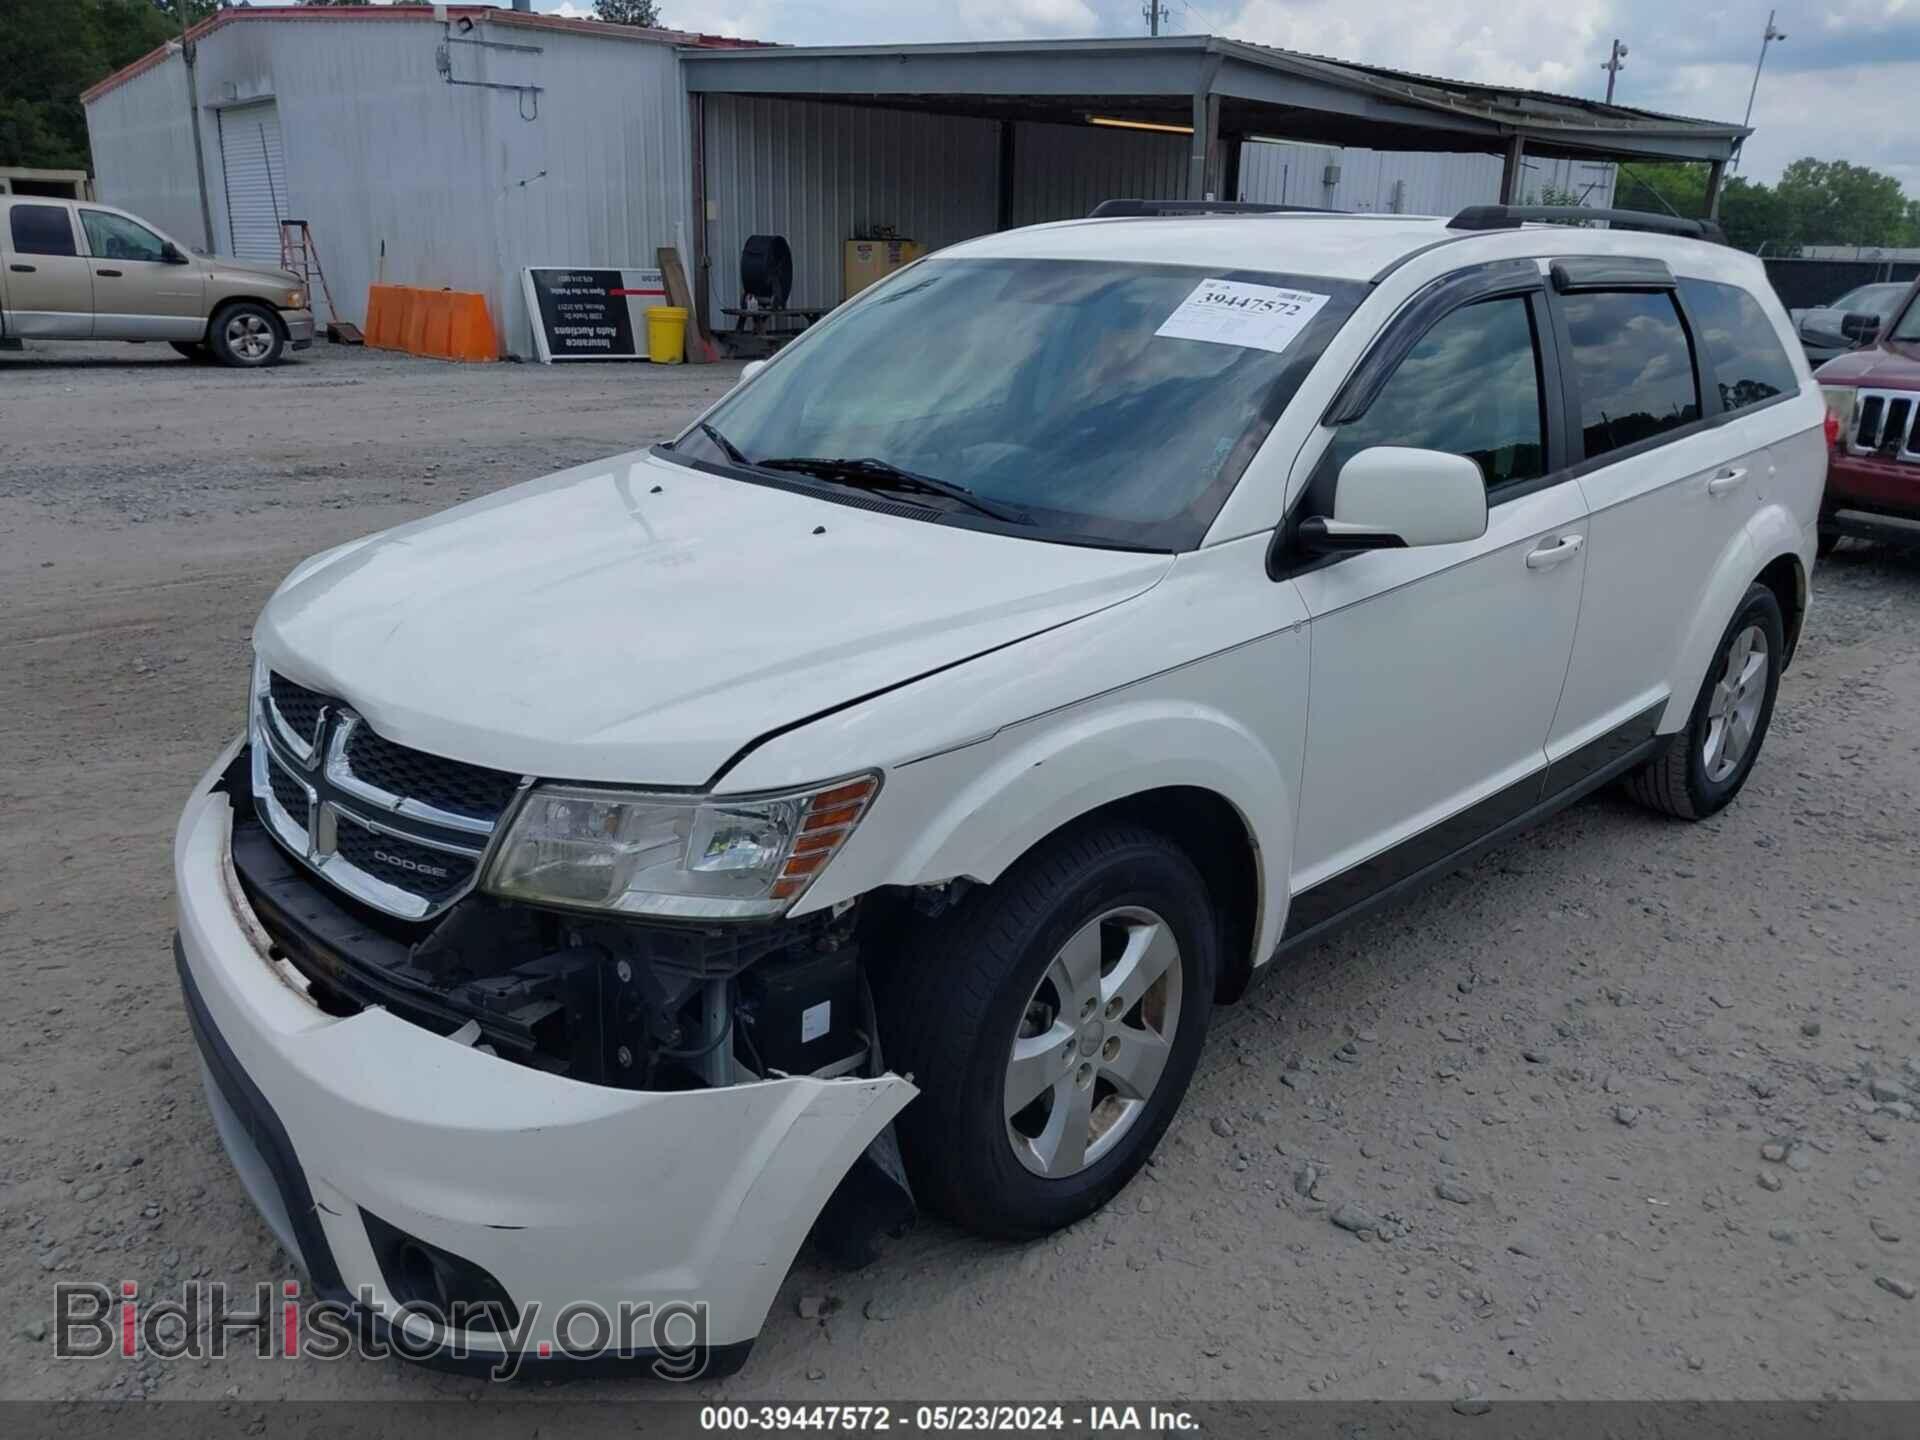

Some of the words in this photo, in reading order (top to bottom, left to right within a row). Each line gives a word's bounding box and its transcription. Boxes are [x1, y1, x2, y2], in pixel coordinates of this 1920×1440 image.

[1198, 291, 1302, 317] 39447572
[554, 326, 595, 337] Auctions
[596, 326, 617, 337] Auto
[566, 338, 610, 348] Insurance
[373, 850, 448, 878] DODGE
